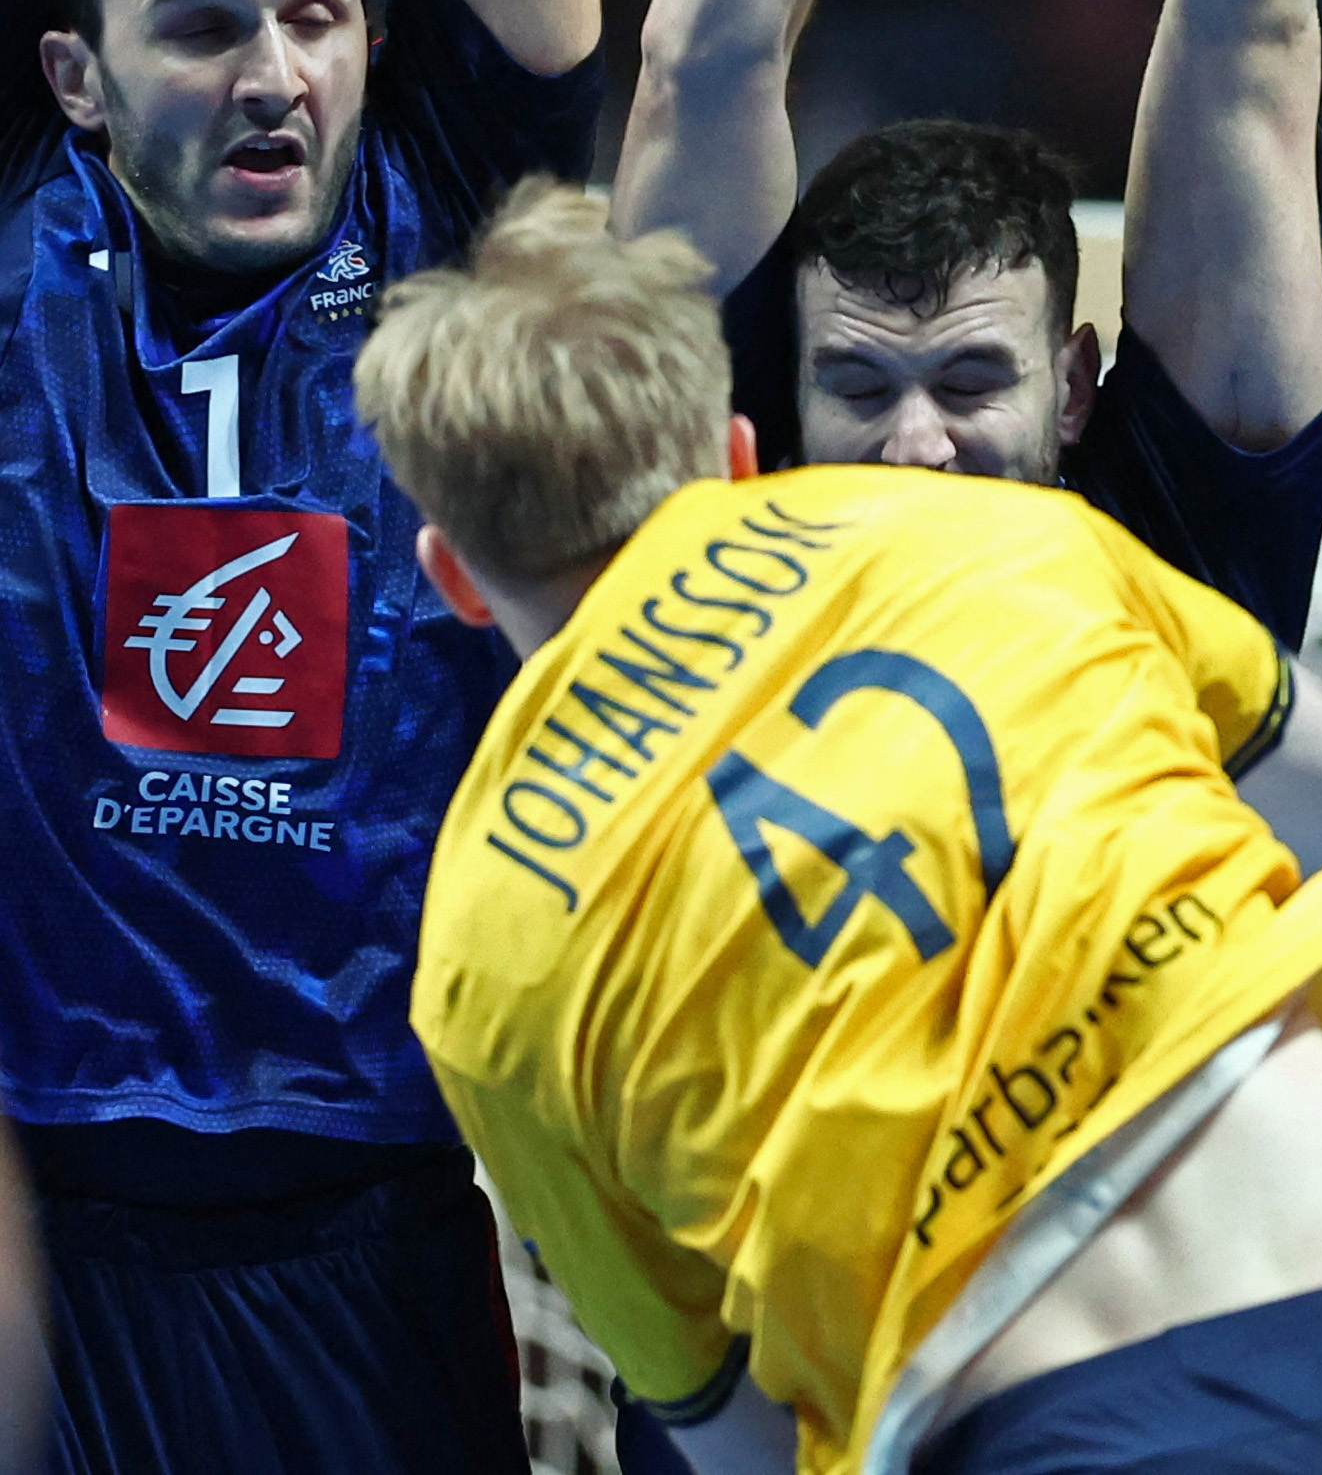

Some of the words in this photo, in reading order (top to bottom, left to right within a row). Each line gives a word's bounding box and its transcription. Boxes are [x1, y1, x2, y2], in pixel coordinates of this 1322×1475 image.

[181, 355, 240, 498] 1
[139, 770, 292, 815] CAISSE
[93, 797, 335, 852] D'EPARGNE
